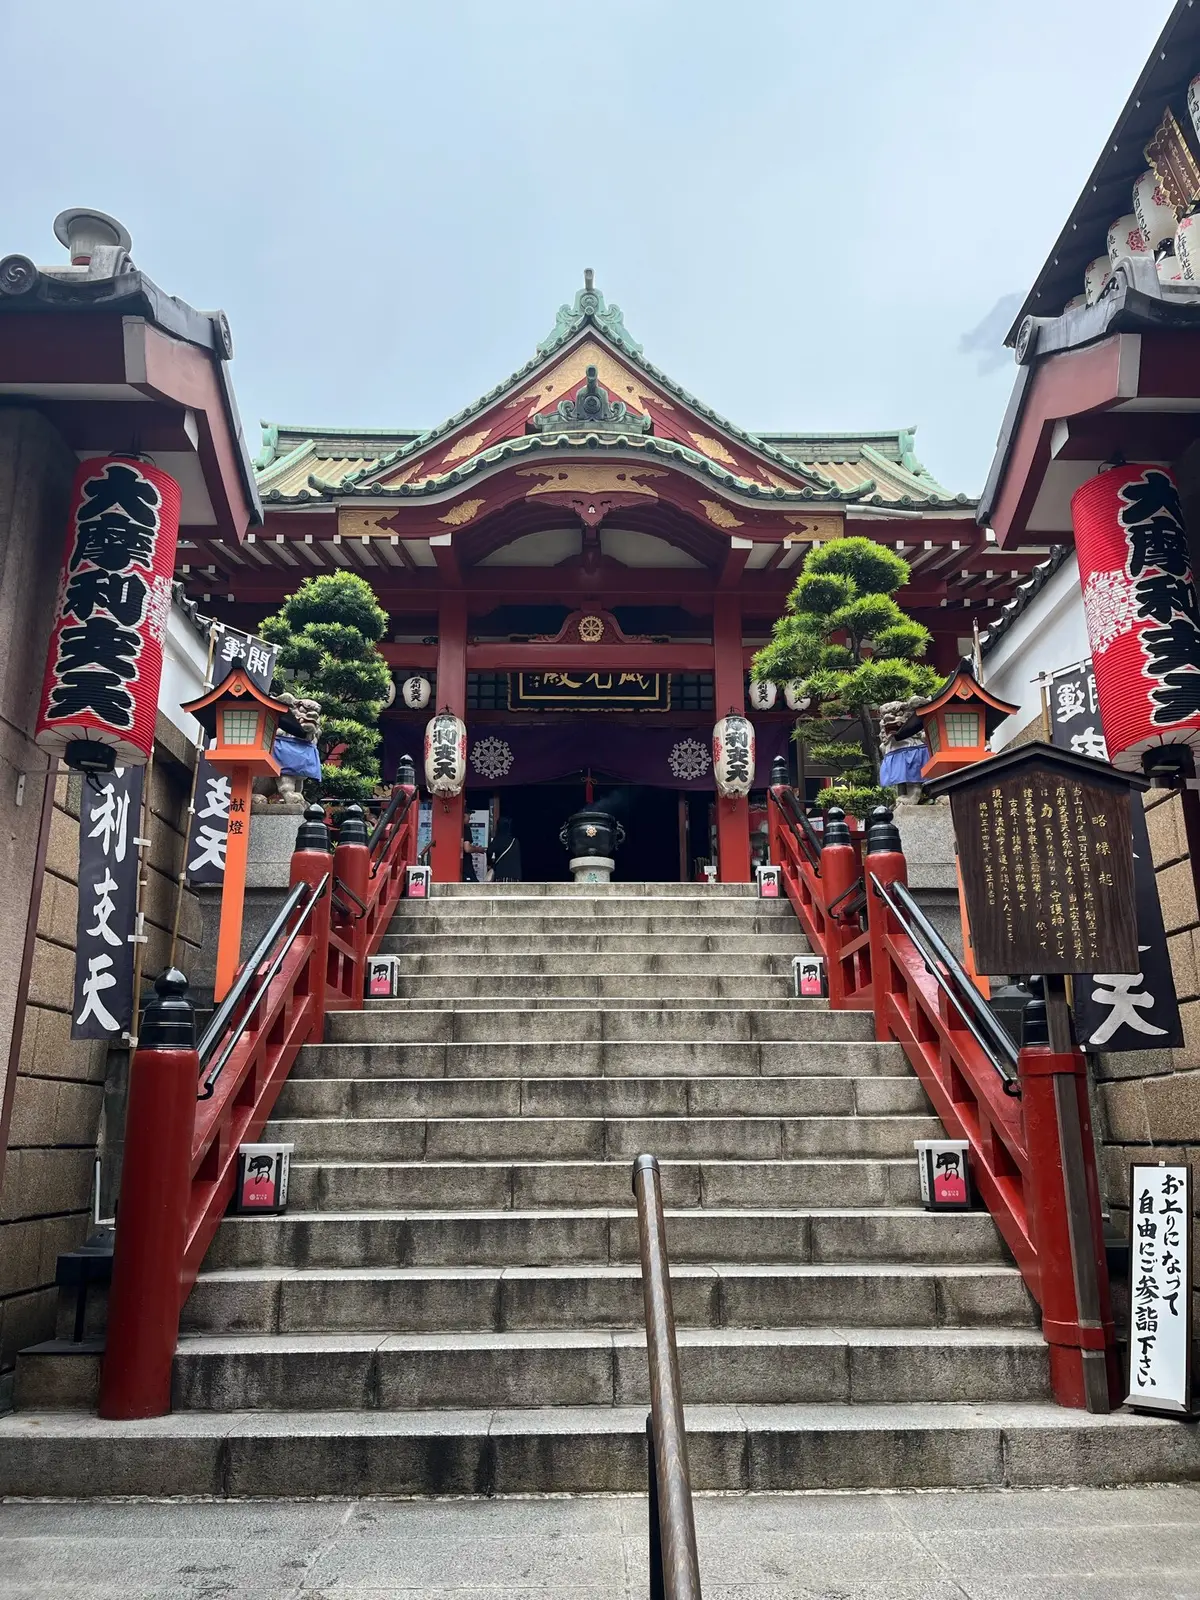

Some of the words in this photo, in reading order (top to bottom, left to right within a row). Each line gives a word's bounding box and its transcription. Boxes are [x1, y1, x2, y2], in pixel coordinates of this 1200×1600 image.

[757, 681, 769, 703] 利支天
[432, 715, 457, 781] 摩利支天
[725, 717, 749, 783] 摩利支天
[76, 767, 131, 1031] 利支天
[1134, 1188, 1160, 1388] 自由にご参詣下さい
[1158, 1173, 1185, 1317] お上りになって
